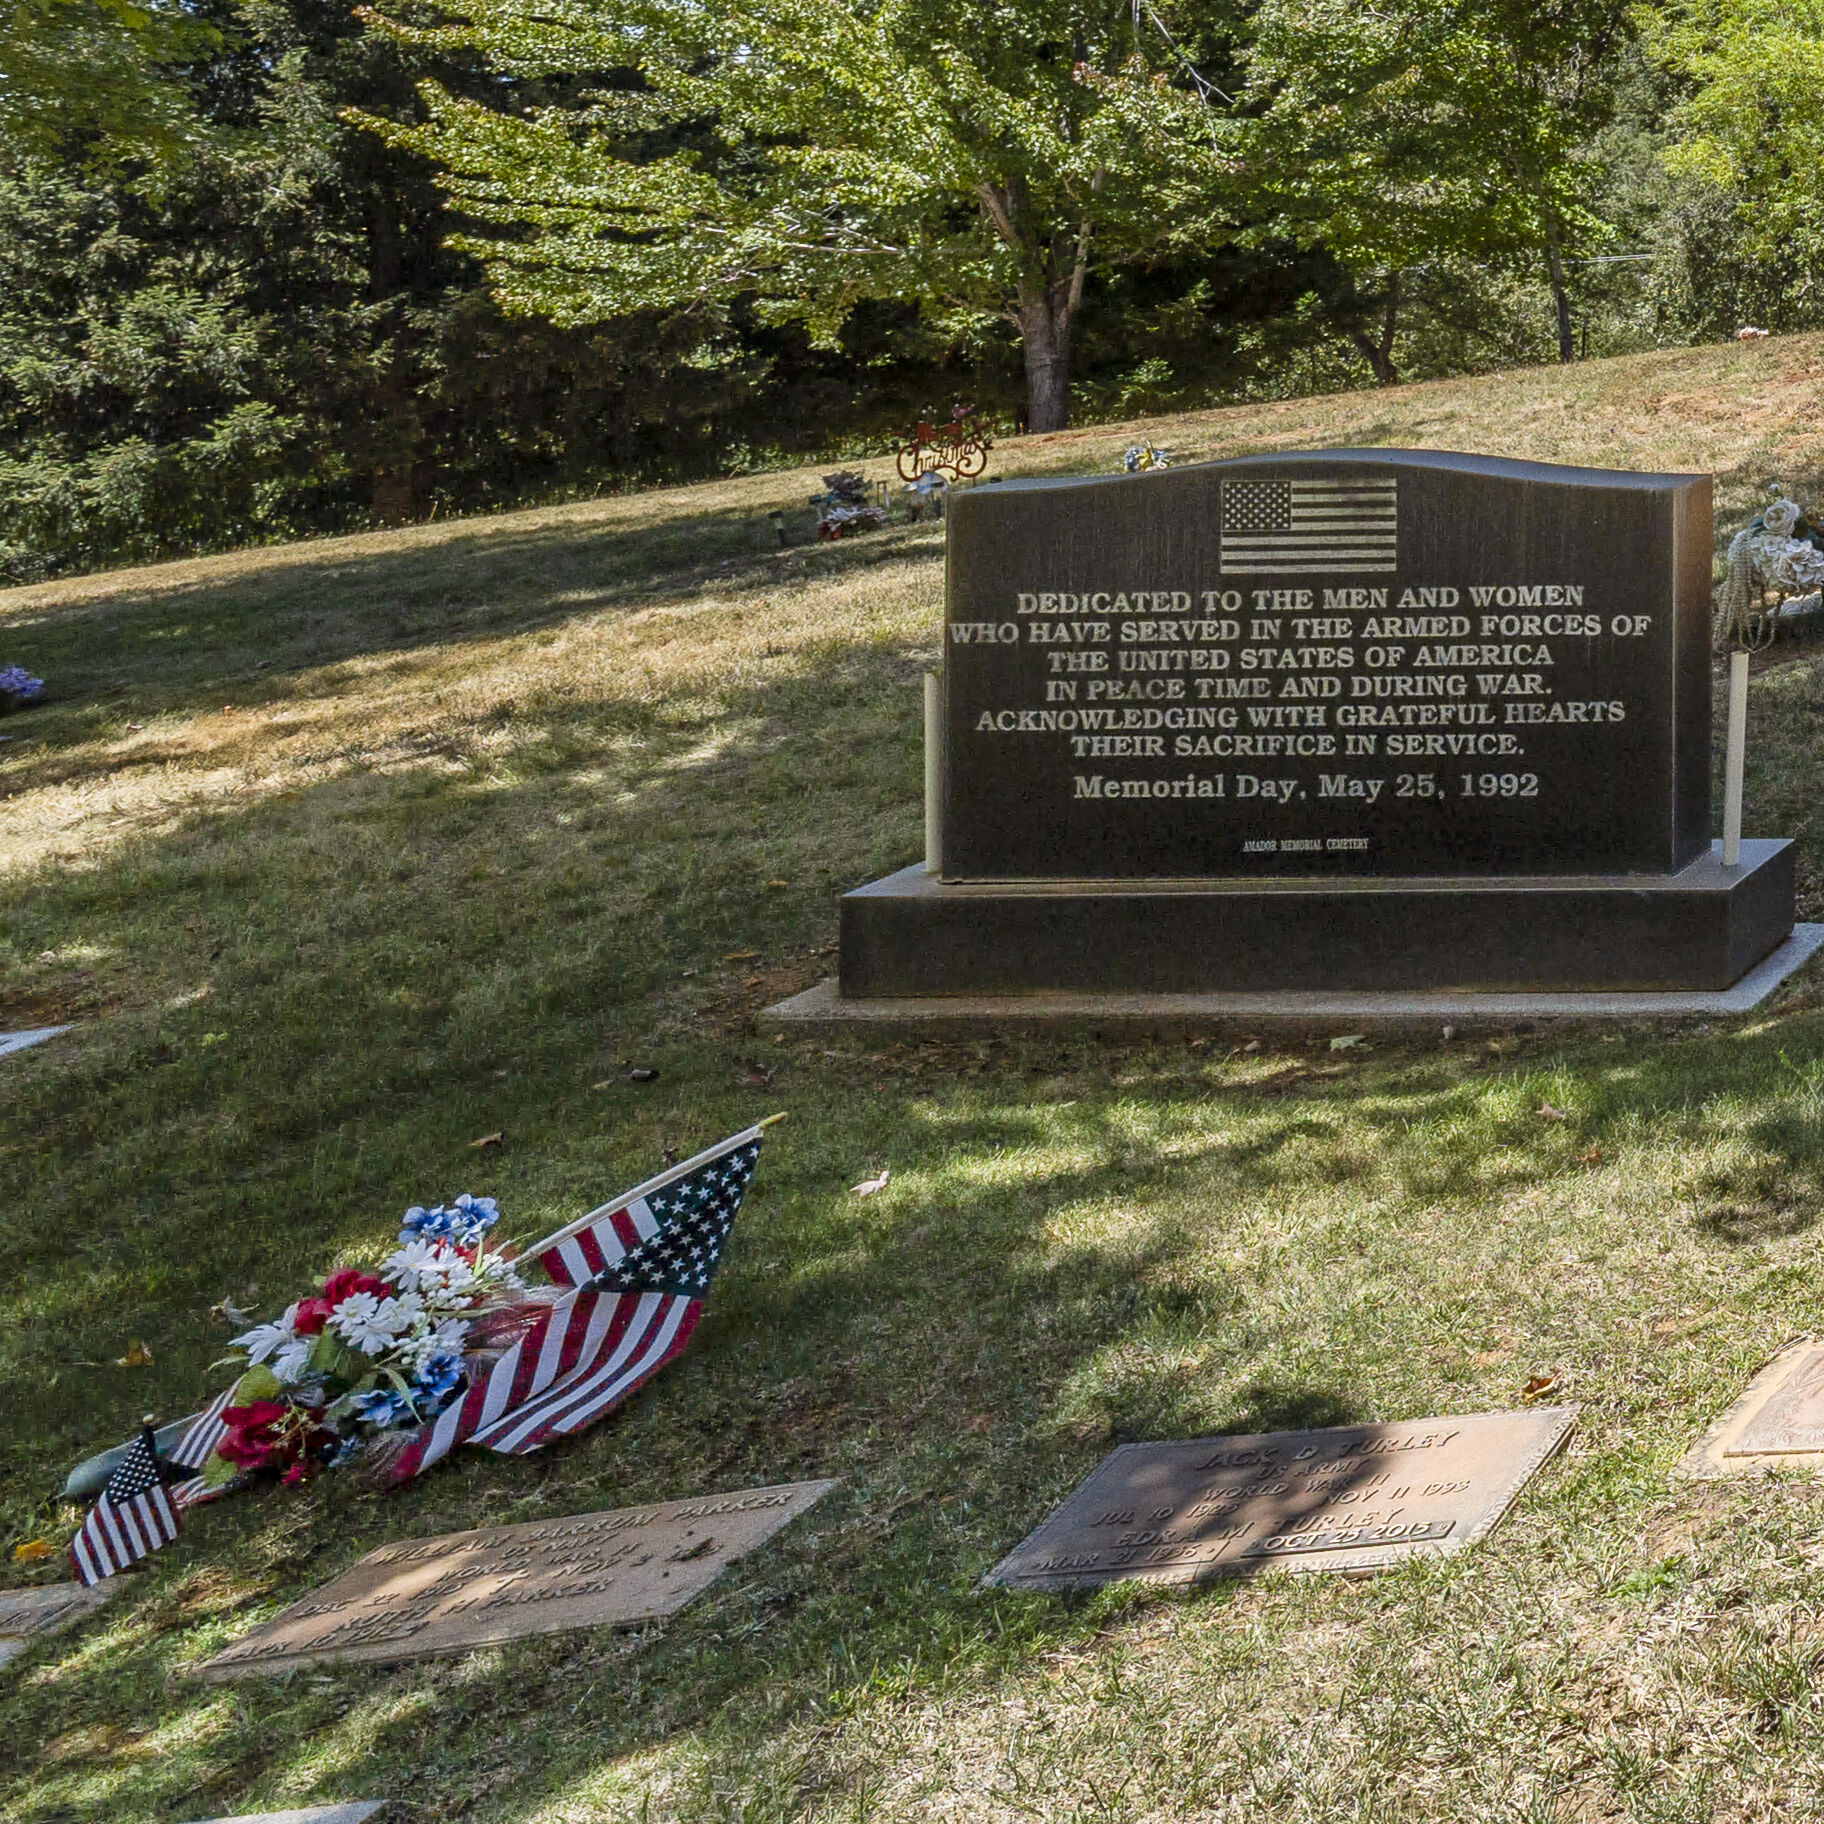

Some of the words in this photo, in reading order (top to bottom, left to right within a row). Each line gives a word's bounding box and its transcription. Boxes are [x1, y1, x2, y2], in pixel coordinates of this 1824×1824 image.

[896, 434, 988, 483] Christmas
[1016, 592, 1192, 614] DEDICATED
[1200, 591, 1242, 611] TO
[1252, 590, 1313, 610] THE
[1322, 588, 1389, 609] MEN
[1397, 587, 1460, 608] AND
[1469, 586, 1583, 608] WOMEN
[950, 623, 1019, 644] WHO
[1029, 622, 1111, 643] HAVE
[1120, 620, 1240, 642] SERVED
[1250, 620, 1281, 640] IN
[1291, 618, 1353, 640] THE
[1360, 617, 1470, 638] ARMED
[1480, 615, 1601, 636] FORCES
[1611, 615, 1652, 636] OF
[1048, 651, 1109, 673] THE
[1118, 649, 1230, 672] UNITED
[1240, 646, 1354, 670] STATES
[1365, 646, 1406, 667] OF
[1413, 644, 1554, 667] AMERICA
[1046, 680, 1078, 701] IN
[1087, 679, 1186, 700] PEACE
[1194, 678, 1271, 699] TIME
[1279, 676, 1341, 698] AND
[1351, 675, 1468, 697] DURING
[1476, 674, 1552, 695] WAR.
[975, 707, 1239, 731] ACKNOWLEDGING
[1247, 705, 1326, 727] WITH
[1336, 704, 1496, 726] GRATEFUL
[1504, 701, 1626, 724] HEARTS
[1071, 736, 1166, 757] THEIR
[1175, 734, 1336, 756] SACRIFICE
[1346, 734, 1376, 755] IN
[1386, 733, 1525, 755] SERVICE.
[1074, 774, 1225, 800] Memorial
[1236, 775, 1307, 804] Day,
[1318, 774, 1385, 804] May
[1396, 774, 1446, 800] 25,
[1459, 772, 1539, 797] 1992
[1243, 840, 1277, 853] AMADOR
[1280, 839, 1322, 852] MEMORIAL
[1326, 838, 1369, 851] CEMETERY
[1193, 1448, 1282, 1470] JACK
[1293, 1444, 1319, 1460] D
[1338, 1432, 1459, 1455] TURLEY
[1256, 1465, 1289, 1479] US
[1295, 1457, 1371, 1475] ARMY
[1199, 1483, 1291, 1501] WORLD
[1302, 1476, 1353, 1492] WAR
[1368, 1472, 1391, 1486] II
[1090, 1510, 1137, 1526] JUL
[1147, 1506, 1175, 1521] 10
[1186, 1500, 1241, 1518] 1925
[1323, 1488, 1379, 1505] NOV
[1388, 1484, 1412, 1499] 11
[373, 1536, 512, 1563] WILLIAM
[667, 1493, 798, 1519] PARKER
[1112, 1524, 1207, 1547] EDRA
[1220, 1521, 1253, 1540] M
[1275, 1507, 1405, 1532] TURLEY
[1263, 1531, 1322, 1550] OCT
[1328, 1528, 1360, 1544] 25
[1370, 1520, 1432, 1539] 2015
[500, 1544, 534, 1559] US
[540, 1533, 619, 1552] NAVY
[1038, 1552, 1101, 1571] MAR
[1111, 1549, 1137, 1564] 21
[436, 1559, 532, 1580] WORLD
[545, 1548, 602, 1565] WAR
[298, 1598, 357, 1615] DEC
[554, 1559, 618, 1578] NOV
[335, 1605, 436, 1630] RUTH
[485, 1580, 616, 1606] PARKER
